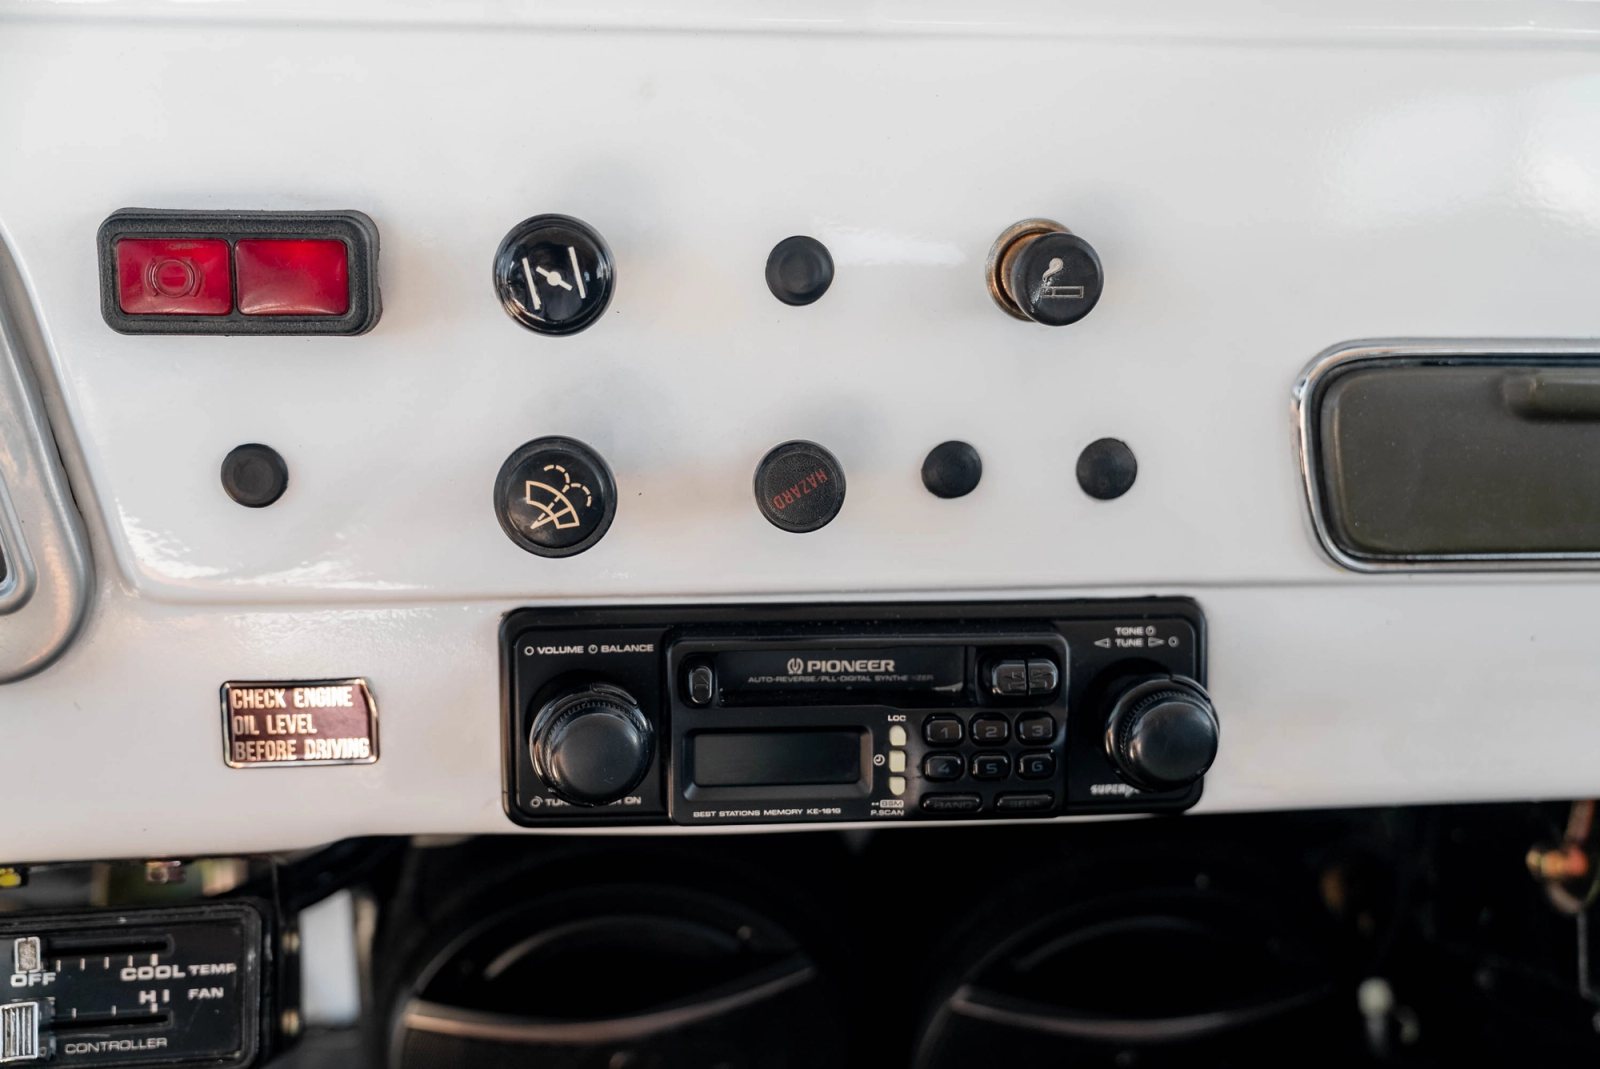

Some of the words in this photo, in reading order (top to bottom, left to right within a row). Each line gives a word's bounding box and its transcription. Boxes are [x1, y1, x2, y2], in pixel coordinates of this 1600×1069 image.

[772, 468, 828, 509] HAZARD
[1114, 626, 1144, 636] TONE
[600, 643, 654, 653] BALANCE
[1115, 637, 1143, 648] TUNE
[537, 645, 584, 655] VOLUME
[806, 659, 896, 673] PIONEER
[874, 674, 934, 682] SYNTHEIZER
[231, 688, 286, 709] CHECK
[293, 686, 354, 708] ENGINE
[233, 715, 260, 735] OIL
[266, 713, 318, 734] LEVEL
[887, 714, 907, 722] LOC
[940, 727, 949, 738] 1
[985, 726, 997, 738] 2
[1031, 724, 1044, 736] 3
[235, 739, 297, 761] BEFORE
[303, 737, 370, 760] DRIVING
[937, 764, 950, 774] 4
[986, 763, 998, 774] 5
[1031, 760, 1044, 772] 6
[623, 796, 642, 806] ON
[693, 810, 716, 818] BEST
[718, 809, 761, 817] STATIONS
[763, 808, 804, 816] MEMORY
[120, 964, 186, 981] COOL
[188, 963, 237, 976] TEMP
[10, 972, 57, 988] OFF
[139, 989, 170, 1005] HI
[188, 987, 224, 1000] FAN
[64, 1037, 168, 1055] CONTROLLER
